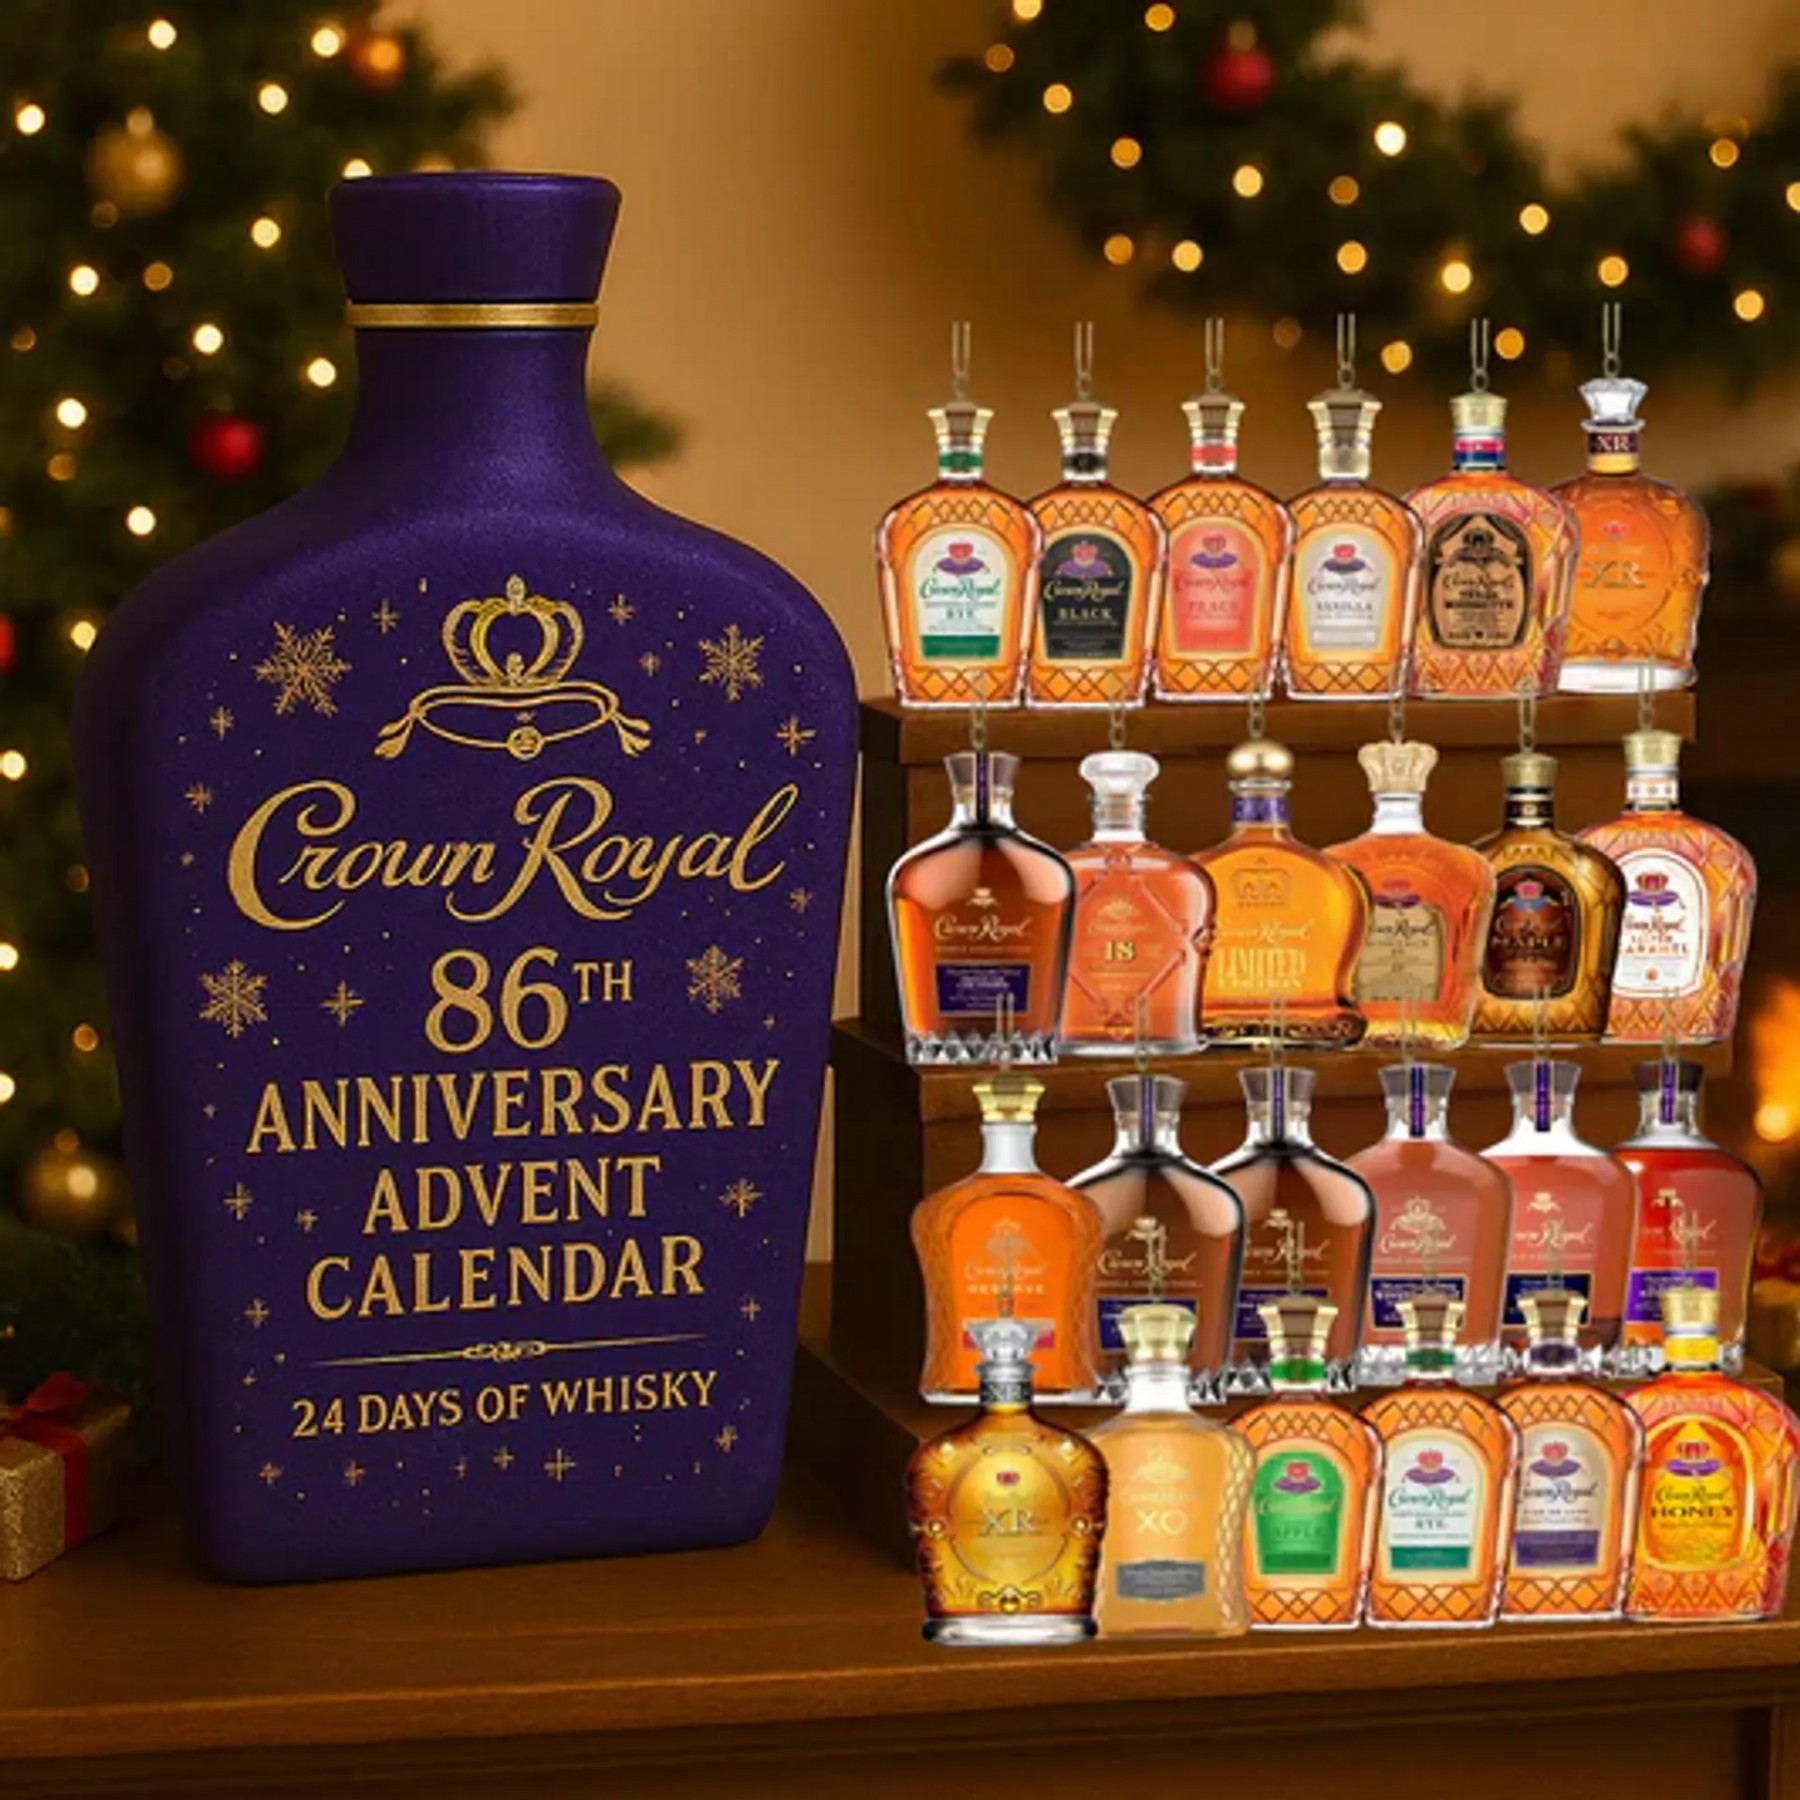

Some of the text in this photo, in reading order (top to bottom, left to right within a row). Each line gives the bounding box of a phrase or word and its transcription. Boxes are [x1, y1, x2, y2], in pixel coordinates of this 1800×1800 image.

[1596, 434, 1631, 452] XR
[1058, 607, 1113, 620] BLACK
[228, 777, 799, 931] Crown Royal
[933, 914, 1034, 942] Crown Royal
[1105, 941, 1136, 962] 18
[425, 945, 634, 1054] 86TH
[245, 1058, 783, 1155] ANNIVERSARY
[361, 1154, 662, 1236] ADVENT
[306, 1234, 705, 1320] CALENDAR
[291, 1370, 719, 1438] 24 DAYS OF WHISKY
[979, 1509, 1040, 1538] XR
[1137, 1510, 1189, 1536] XO
[1651, 1506, 1735, 1518] HONEY
